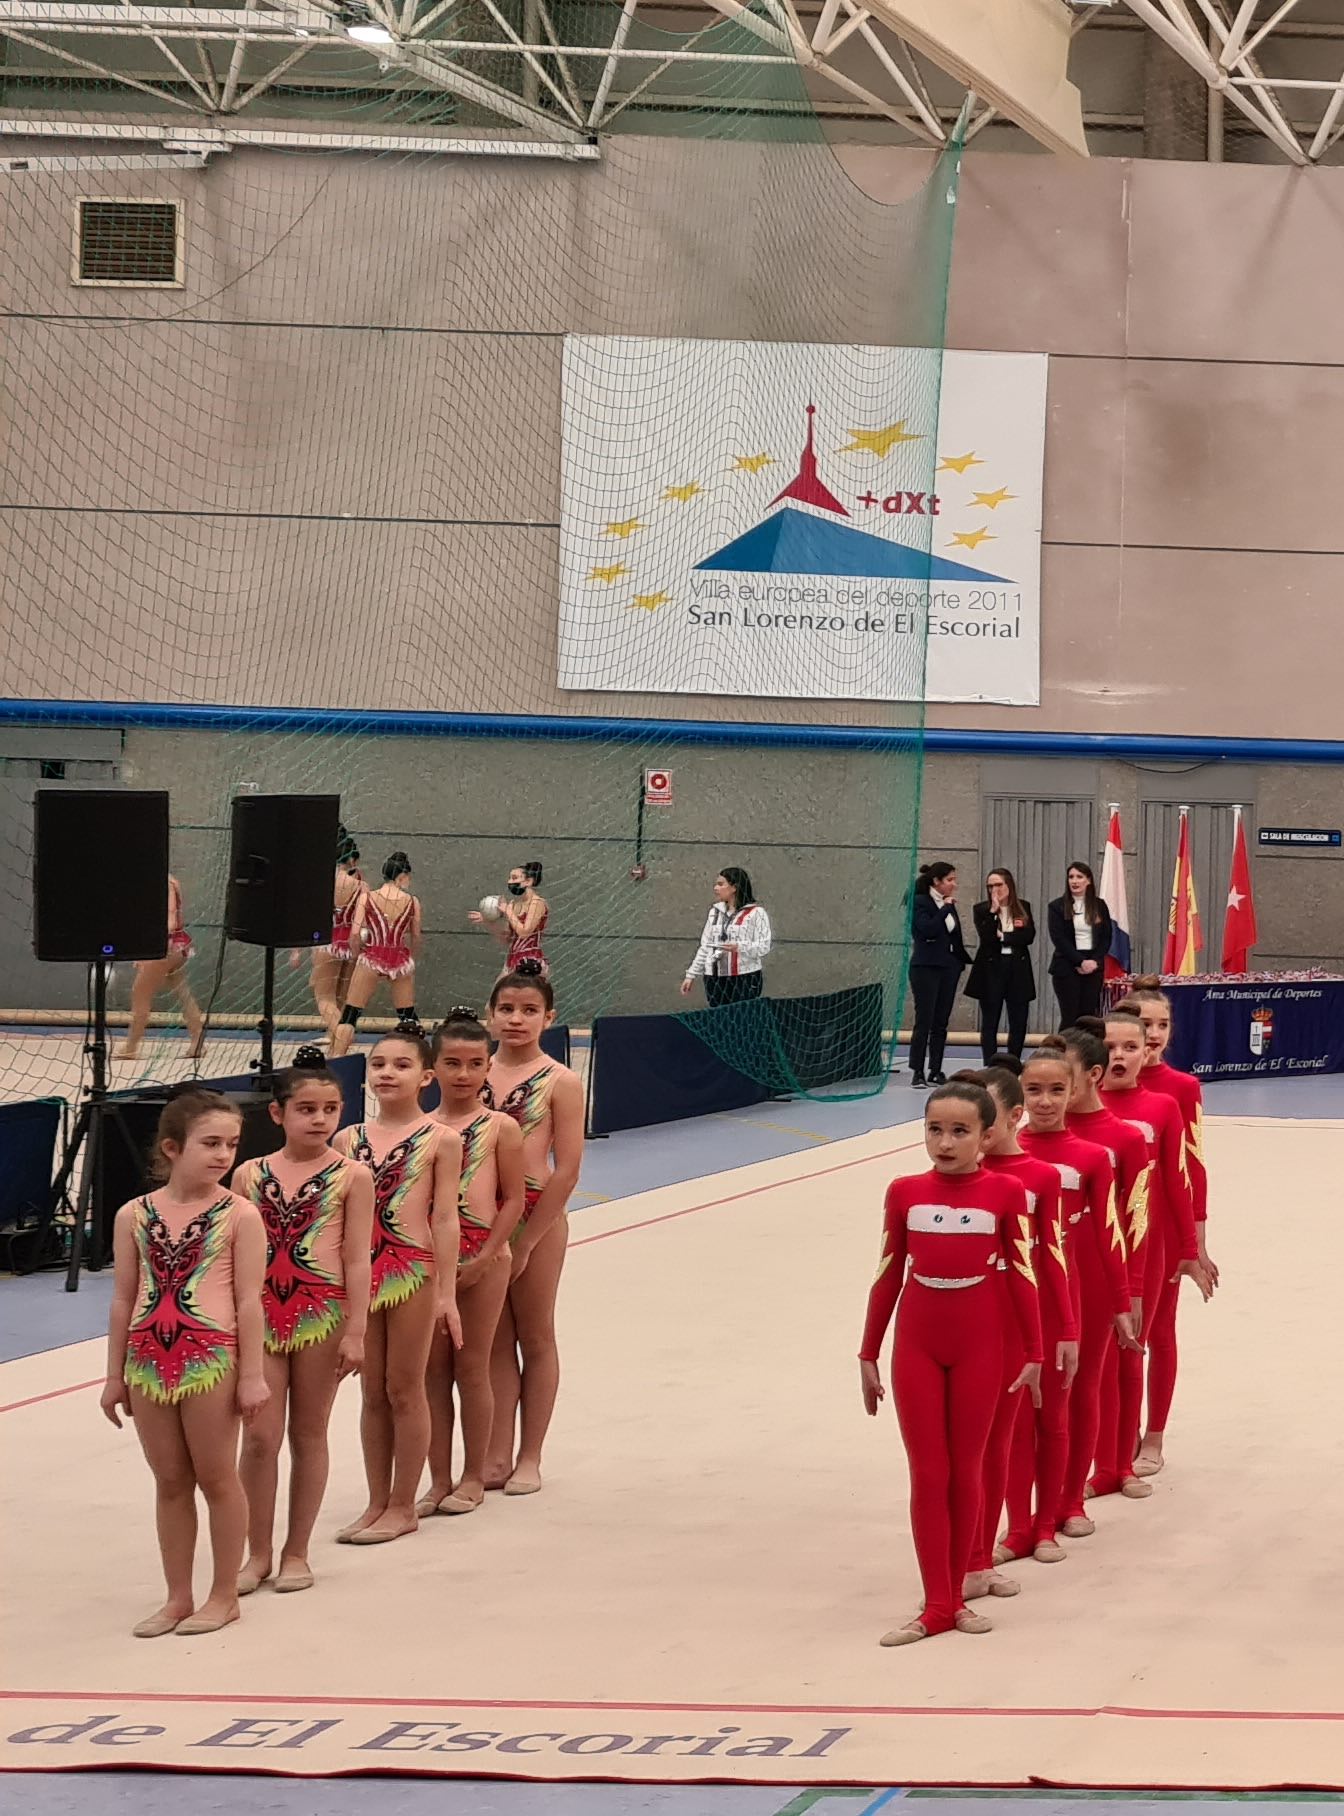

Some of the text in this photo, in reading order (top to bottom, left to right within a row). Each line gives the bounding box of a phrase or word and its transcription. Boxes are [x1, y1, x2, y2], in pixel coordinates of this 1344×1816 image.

[689, 578, 1022, 613] Villa europea del deporte 2011
[688, 604, 1020, 638] San Lorenzo de El Escorial
[1226, 988, 1271, 1002] Municipal
[1272, 987, 1283, 999] de
[1284, 988, 1323, 1001] Deportes
[1190, 1055, 1329, 1075] San Lorenzo de El Escorial
[7, 1714, 854, 1759] de El Escorial
